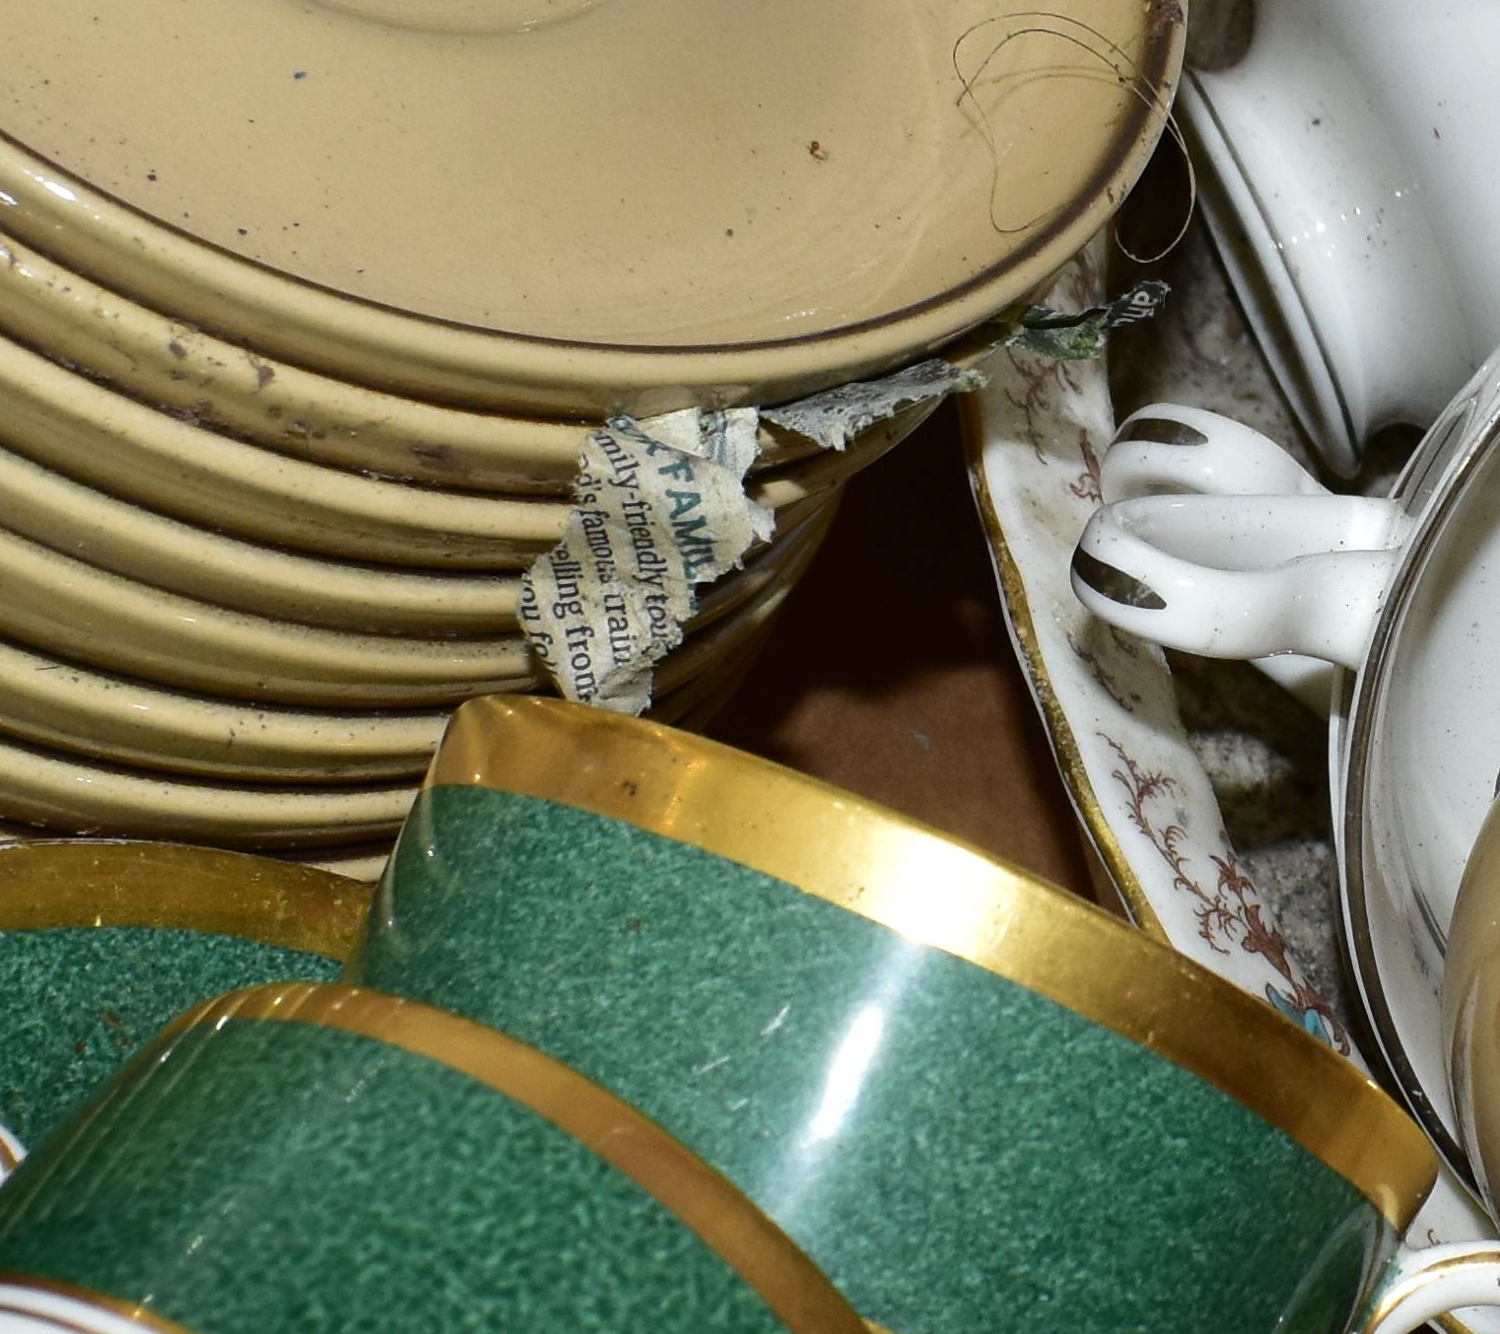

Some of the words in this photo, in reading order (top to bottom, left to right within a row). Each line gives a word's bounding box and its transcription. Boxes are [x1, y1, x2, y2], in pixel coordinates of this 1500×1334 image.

[577, 507, 615, 584] famous
[594, 430, 666, 587] mily-friendly
[657, 457, 716, 614] FAMIL
